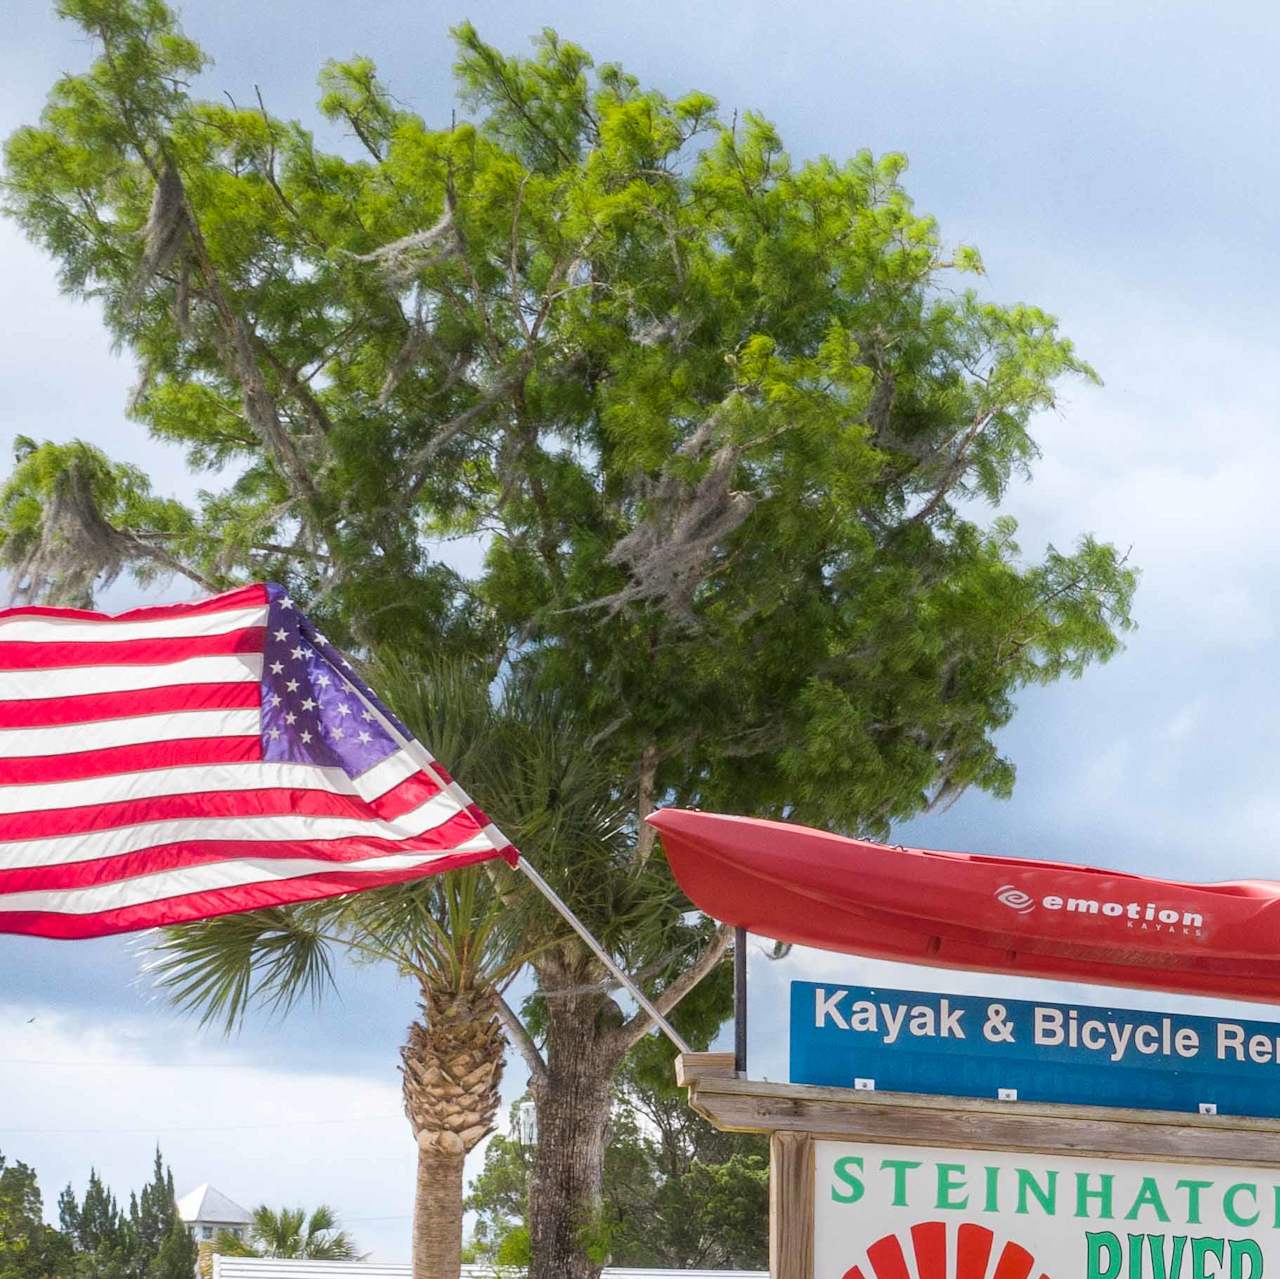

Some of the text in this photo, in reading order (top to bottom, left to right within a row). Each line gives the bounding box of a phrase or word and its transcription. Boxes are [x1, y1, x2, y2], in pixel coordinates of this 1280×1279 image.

[1042, 895, 1203, 928] emotion
[1127, 920, 1201, 937] KAYAKS
[814, 988, 966, 1043] Kayak
[982, 1004, 1014, 1043] &
[1033, 1006, 1200, 1062] Bicycle
